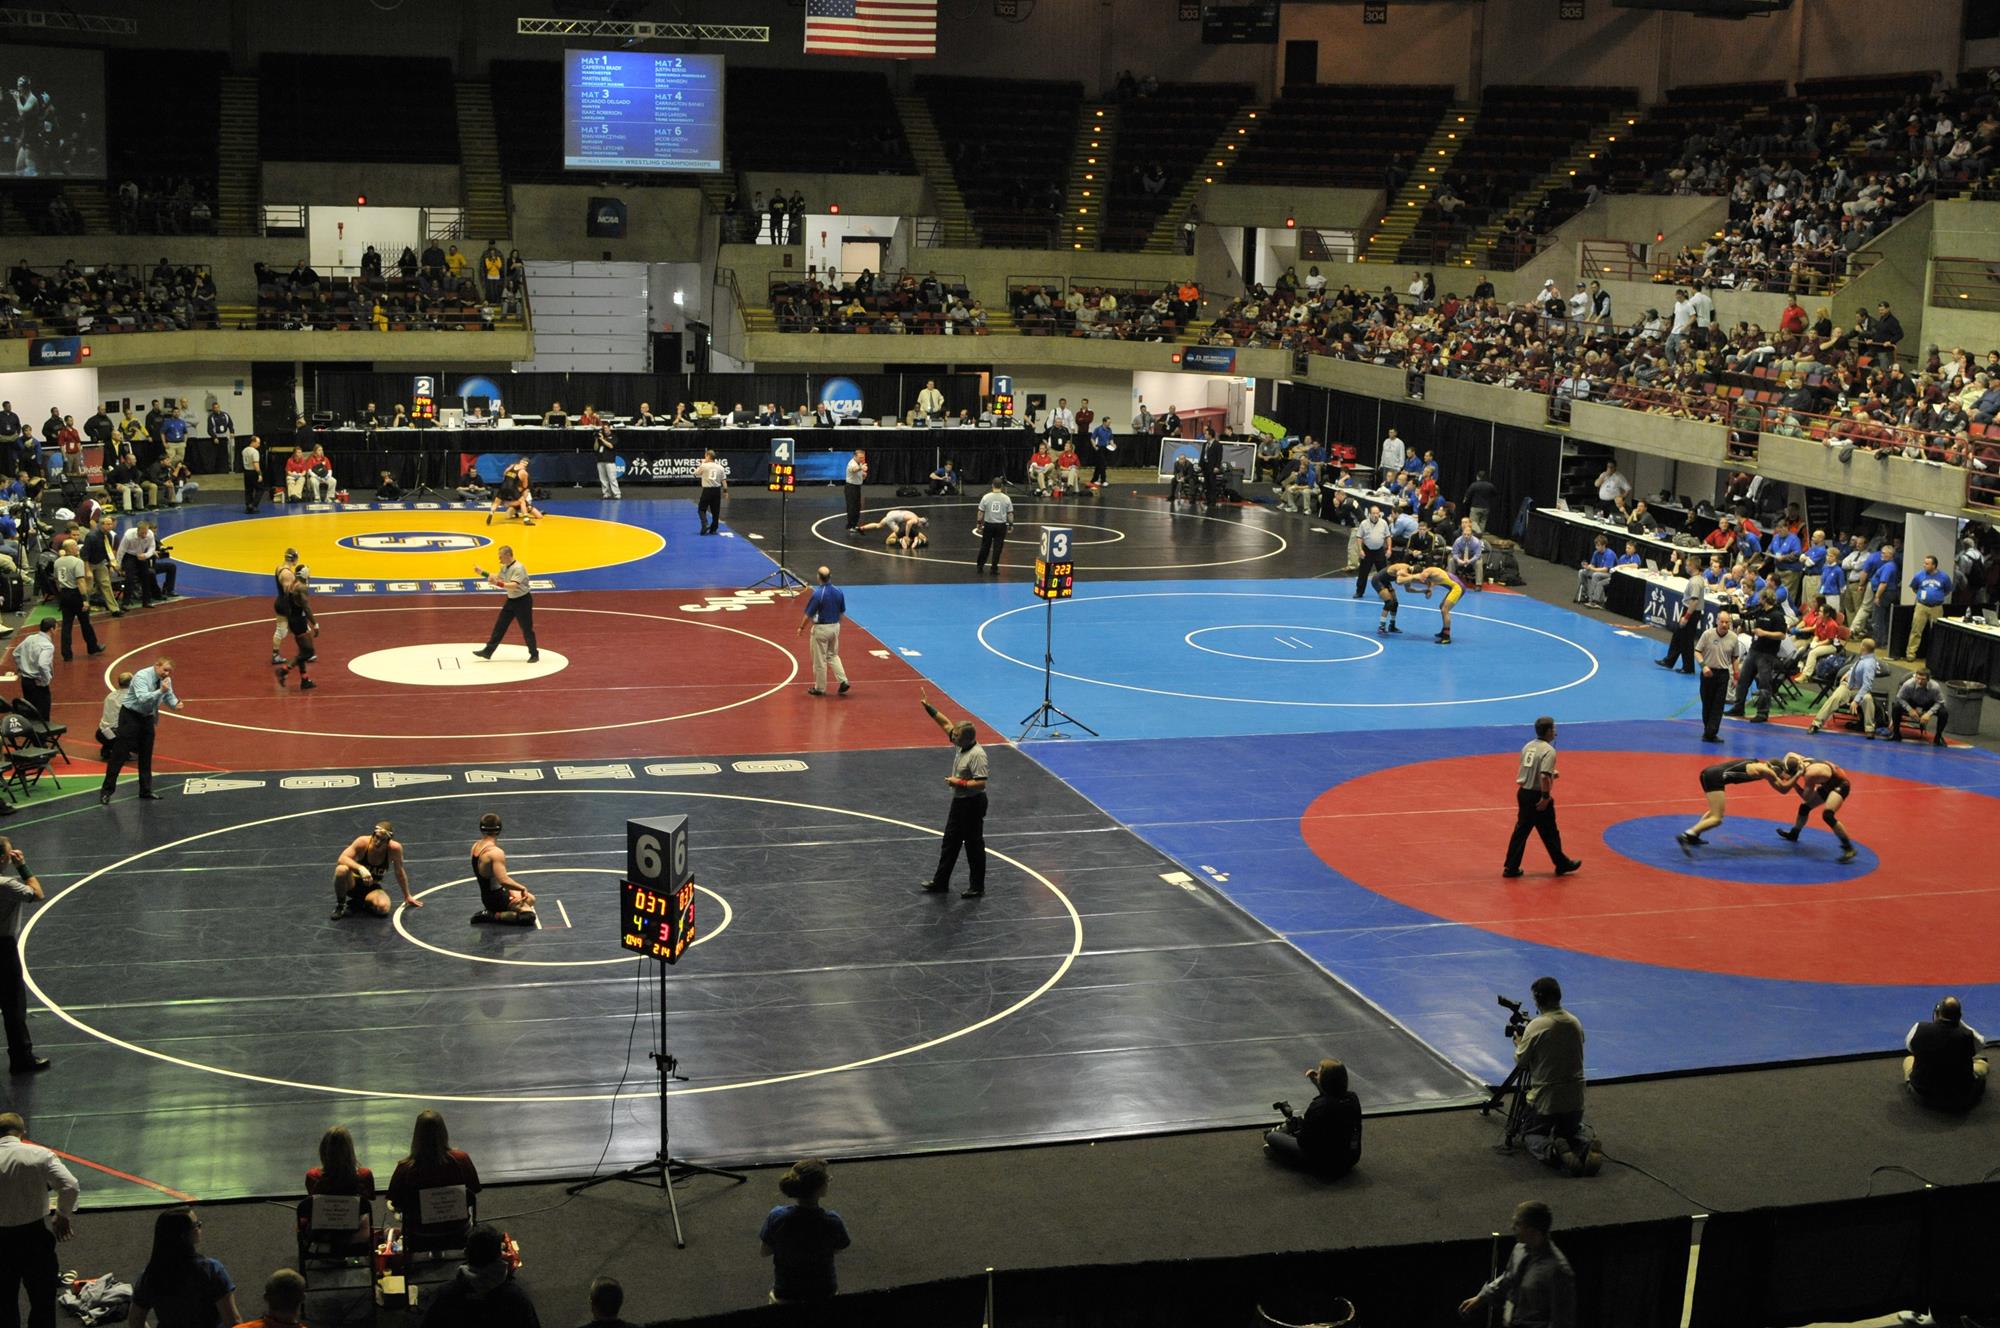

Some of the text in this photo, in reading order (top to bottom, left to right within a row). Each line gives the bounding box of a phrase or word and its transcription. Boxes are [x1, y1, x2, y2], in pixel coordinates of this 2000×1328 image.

[1365, 12, 1385, 21] 304
[1561, 8, 1582, 17] 305
[602, 55, 608, 65] 1
[675, 57, 682, 68] 2
[602, 89, 609, 98] 3
[674, 91, 682, 100] 4
[602, 124, 609, 134] 5
[674, 126, 682, 136] 6
[417, 380, 430, 395] 2
[998, 379, 1006, 393] 1
[775, 442, 790, 461] 4
[652, 458, 728, 467] 2011 WRESTNG
[787, 475, 794, 484] 3
[1041, 532, 1048, 556] 3
[1053, 533, 1068, 557] 3
[1054, 564, 1072, 576] 223
[1052, 576, 1072, 588] 0 0
[1526, 753, 1534, 764] 6
[635, 834, 662, 879] 6
[674, 829, 686, 876] 6
[634, 892, 666, 916] 037
[633, 914, 670, 941] 4 3
[653, 943, 670, 958] 214
